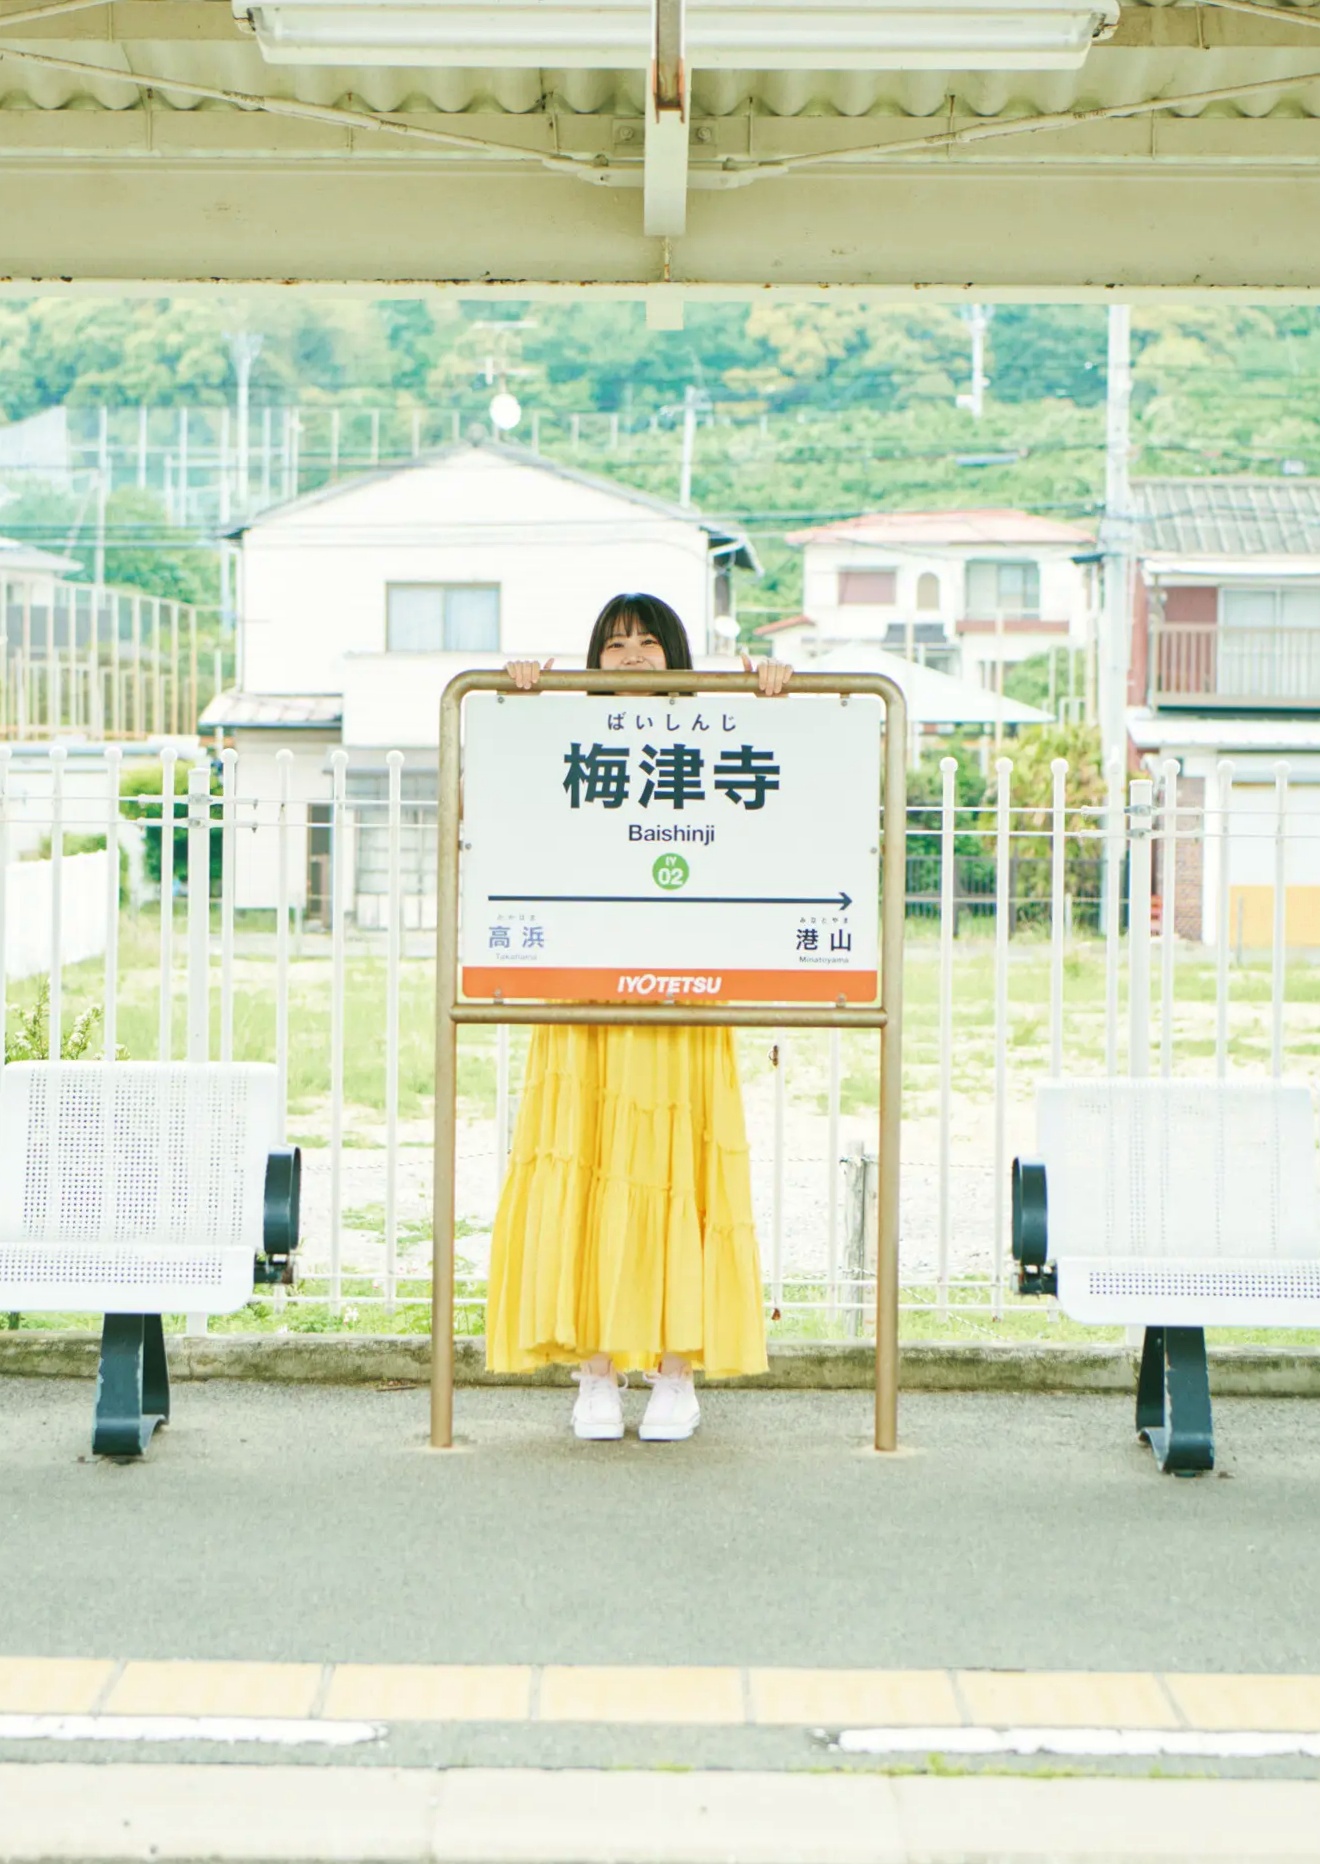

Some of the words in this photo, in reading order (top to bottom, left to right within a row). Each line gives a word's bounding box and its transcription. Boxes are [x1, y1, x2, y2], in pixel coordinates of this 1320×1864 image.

[607, 711, 736, 732] ばいしんじ
[563, 742, 780, 810] 梅津寺
[628, 824, 715, 846] Baishinji
[665, 856, 677, 866] IY
[658, 868, 684, 885] 02
[488, 925, 545, 948] 高浜
[796, 928, 852, 951] 港山
[617, 973, 722, 995] IYOTETSU
